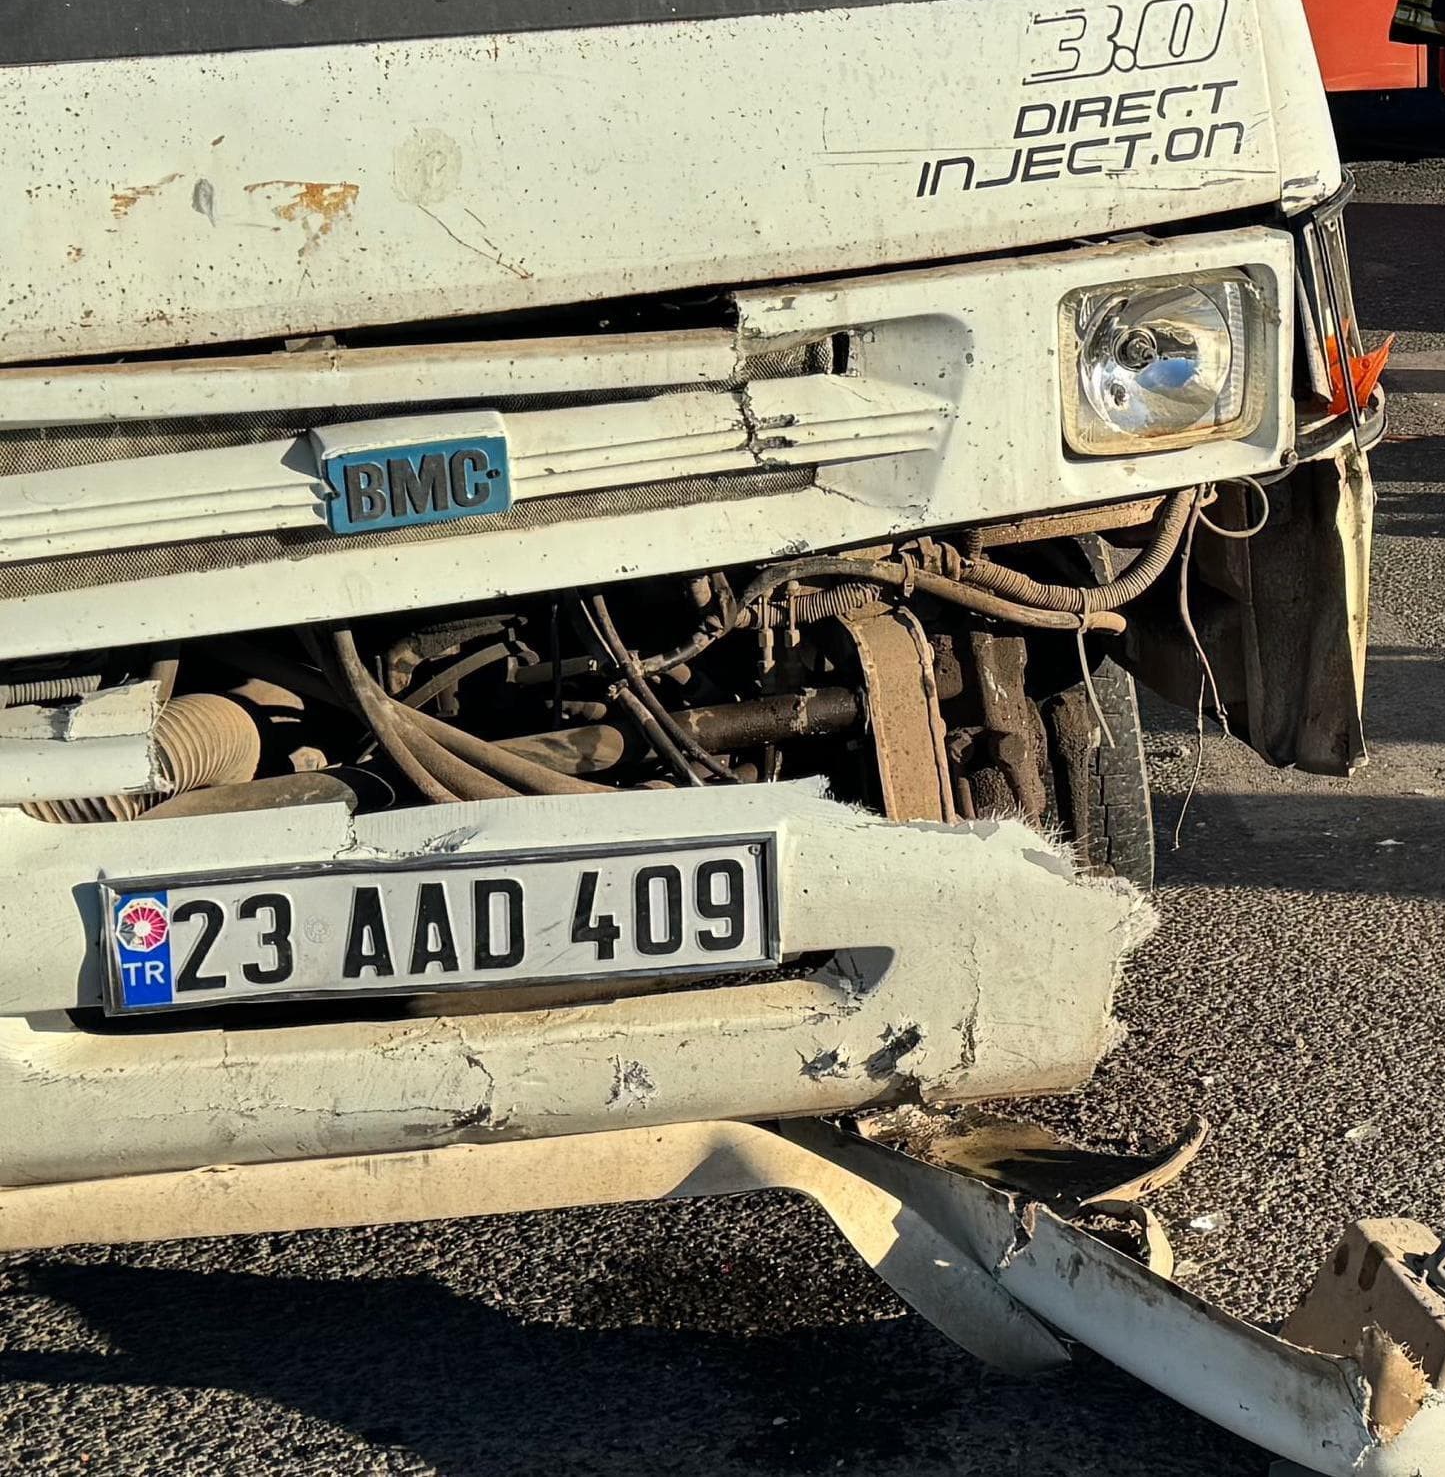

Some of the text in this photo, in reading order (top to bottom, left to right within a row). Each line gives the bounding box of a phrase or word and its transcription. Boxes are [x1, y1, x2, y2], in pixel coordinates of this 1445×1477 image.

[1013, 80, 1240, 139] DIRECT
[344, 449, 491, 523] BMC
[171, 858, 747, 993] 23 AAD 409
[123, 960, 165, 987] TR
